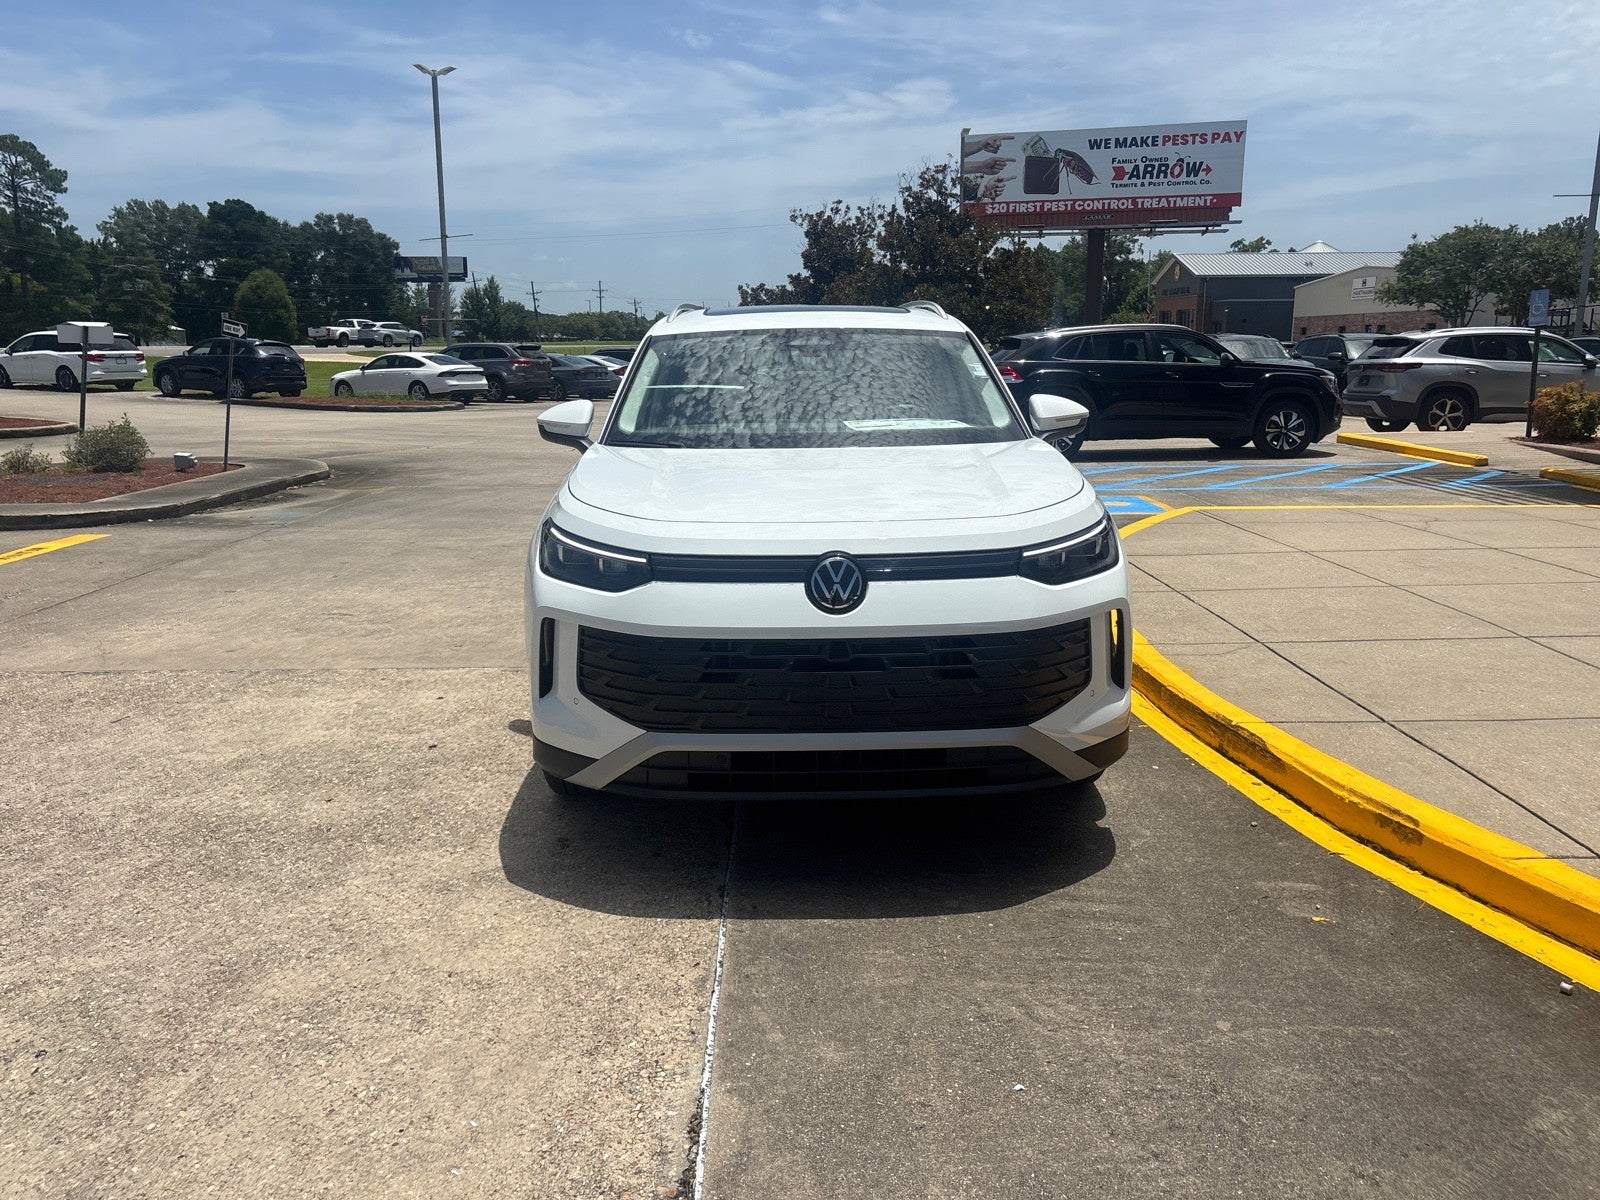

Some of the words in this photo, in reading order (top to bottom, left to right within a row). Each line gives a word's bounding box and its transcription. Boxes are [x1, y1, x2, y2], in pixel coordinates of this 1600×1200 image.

[1088, 137, 1112, 150] WE
[1114, 135, 1159, 149] MAKE
[1161, 132, 1209, 147] PESTS
[1211, 130, 1245, 144] PAY
[1140, 155, 1169, 163] OWNED
[1127, 160, 1204, 180] ARROW
[985, 203, 1007, 215] $20
[1009, 202, 1042, 213] FIRST
[1043, 201, 1074, 211] PEST
[1074, 198, 1135, 211] CONTROL
